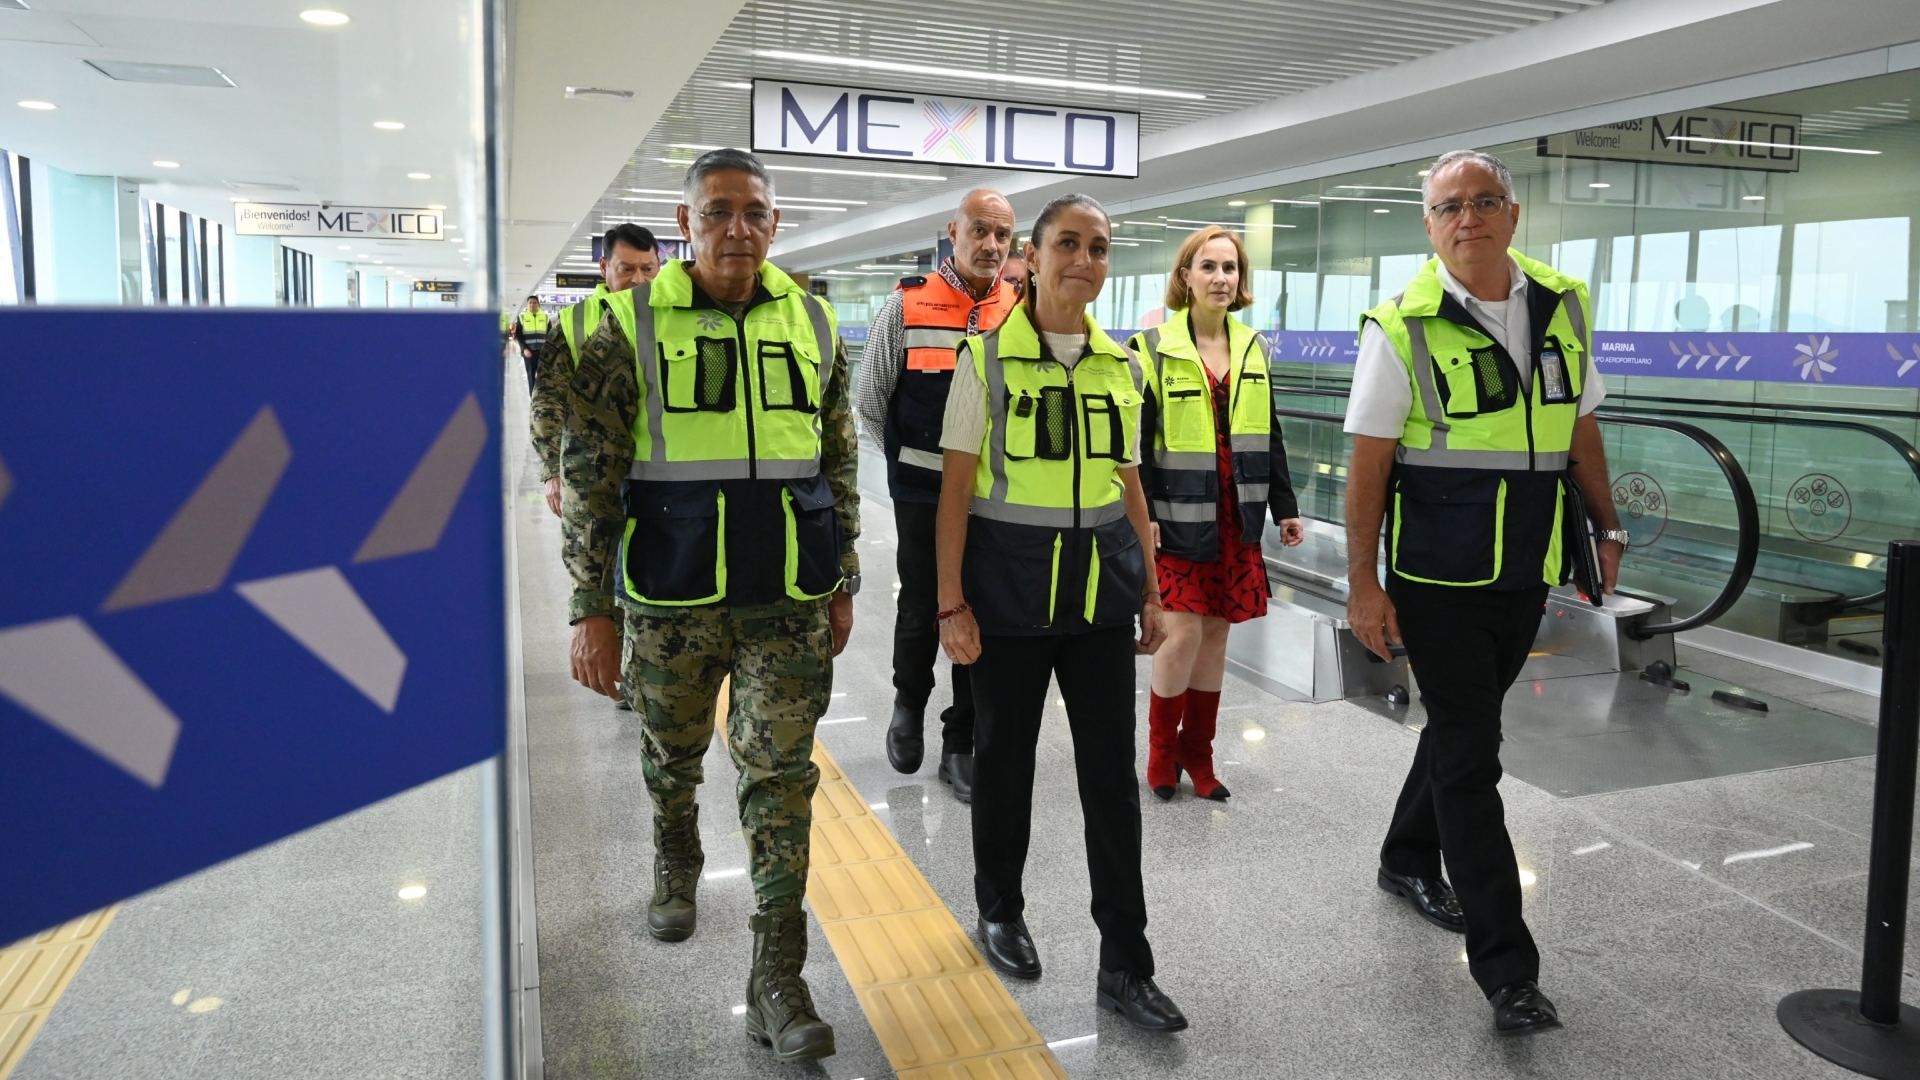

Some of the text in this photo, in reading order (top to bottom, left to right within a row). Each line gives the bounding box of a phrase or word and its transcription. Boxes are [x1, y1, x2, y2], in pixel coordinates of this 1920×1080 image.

[781, 87, 1115, 171] MEXICO
[1575, 131, 1621, 149] Welcome!
[1651, 114, 1795, 161] MEXICO
[240, 209, 310, 221] ¡Bienvenidos!
[317, 211, 438, 234] MEXICO
[257, 223, 294, 231] Welcome!
[1601, 342, 1635, 352] MARINA
[1605, 357, 1653, 365] AEROPORTUARIO
